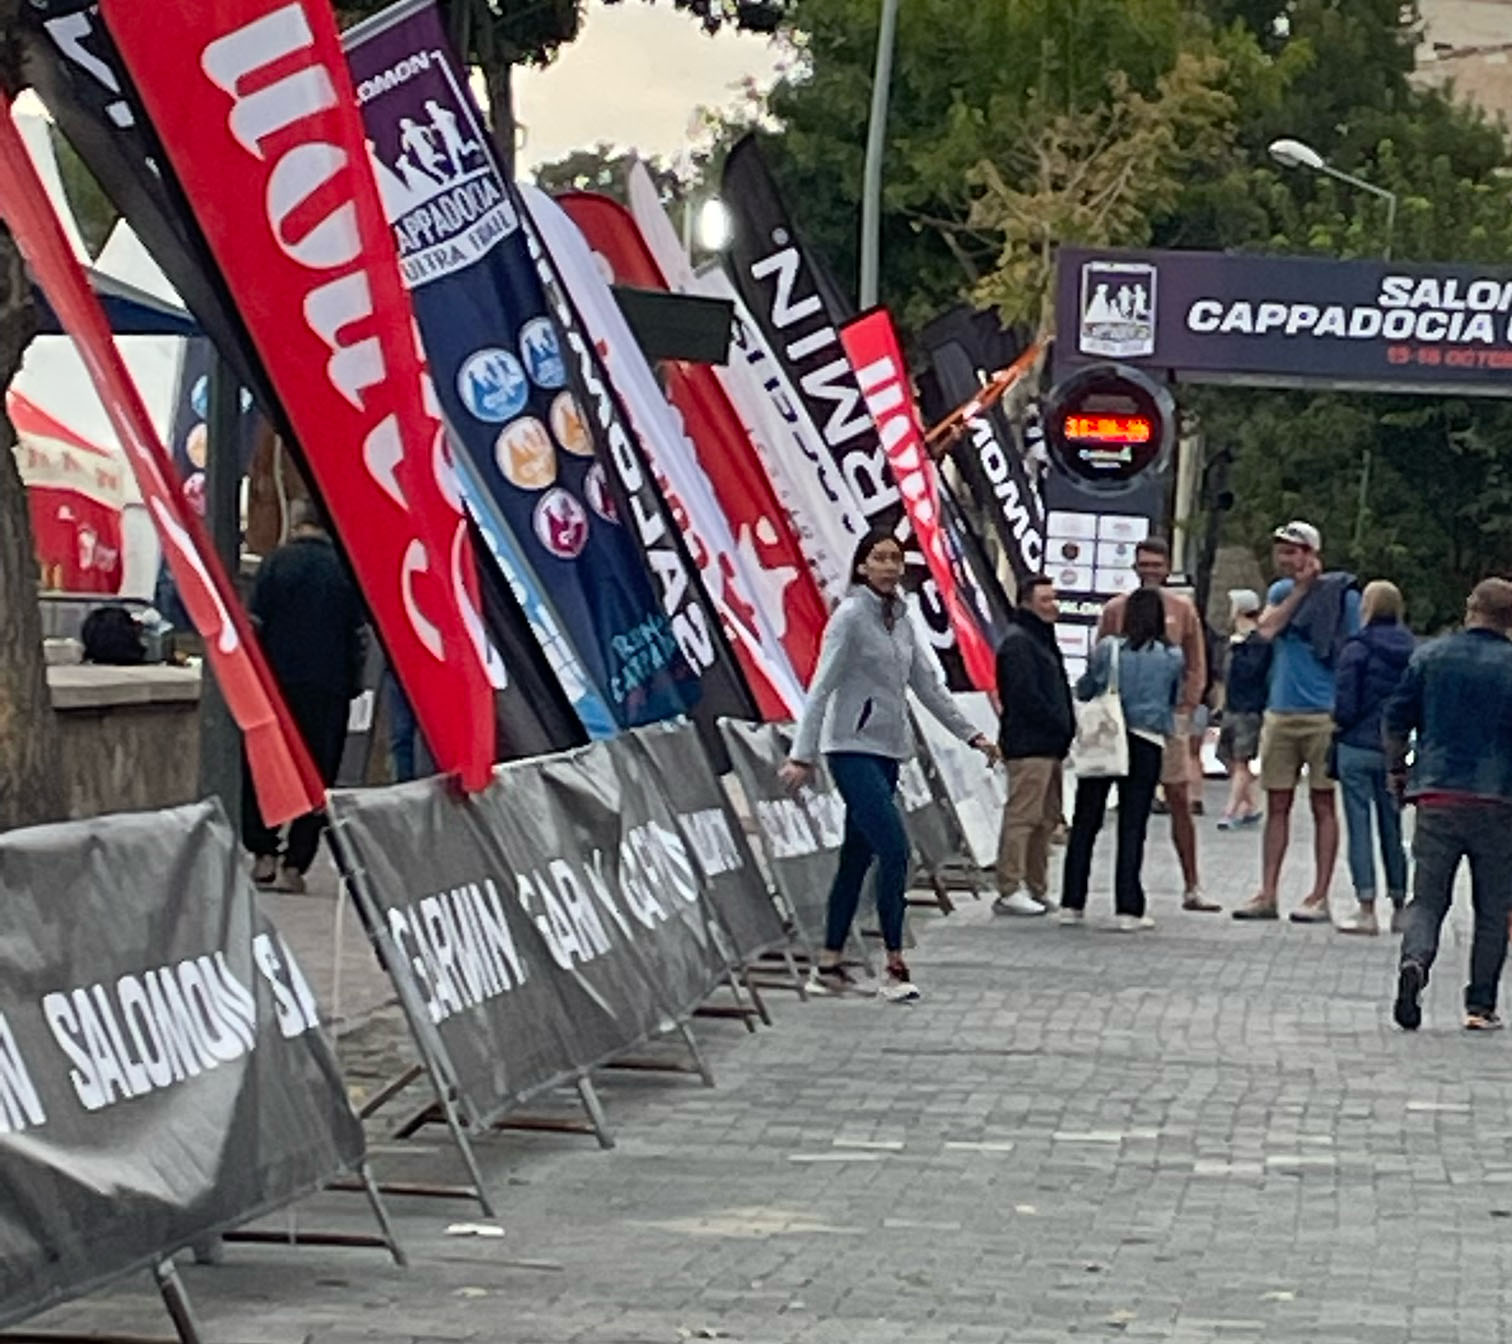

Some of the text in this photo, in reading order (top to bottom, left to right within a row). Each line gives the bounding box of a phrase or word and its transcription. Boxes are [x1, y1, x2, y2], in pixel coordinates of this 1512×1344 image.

[355, 50, 430, 106] OMON
[398, 177, 501, 253] APPADOCIA
[1187, 301, 1494, 344] CAPPADOCIA
[753, 248, 955, 686] GRMIN
[43, 950, 256, 1111] SALOMON
